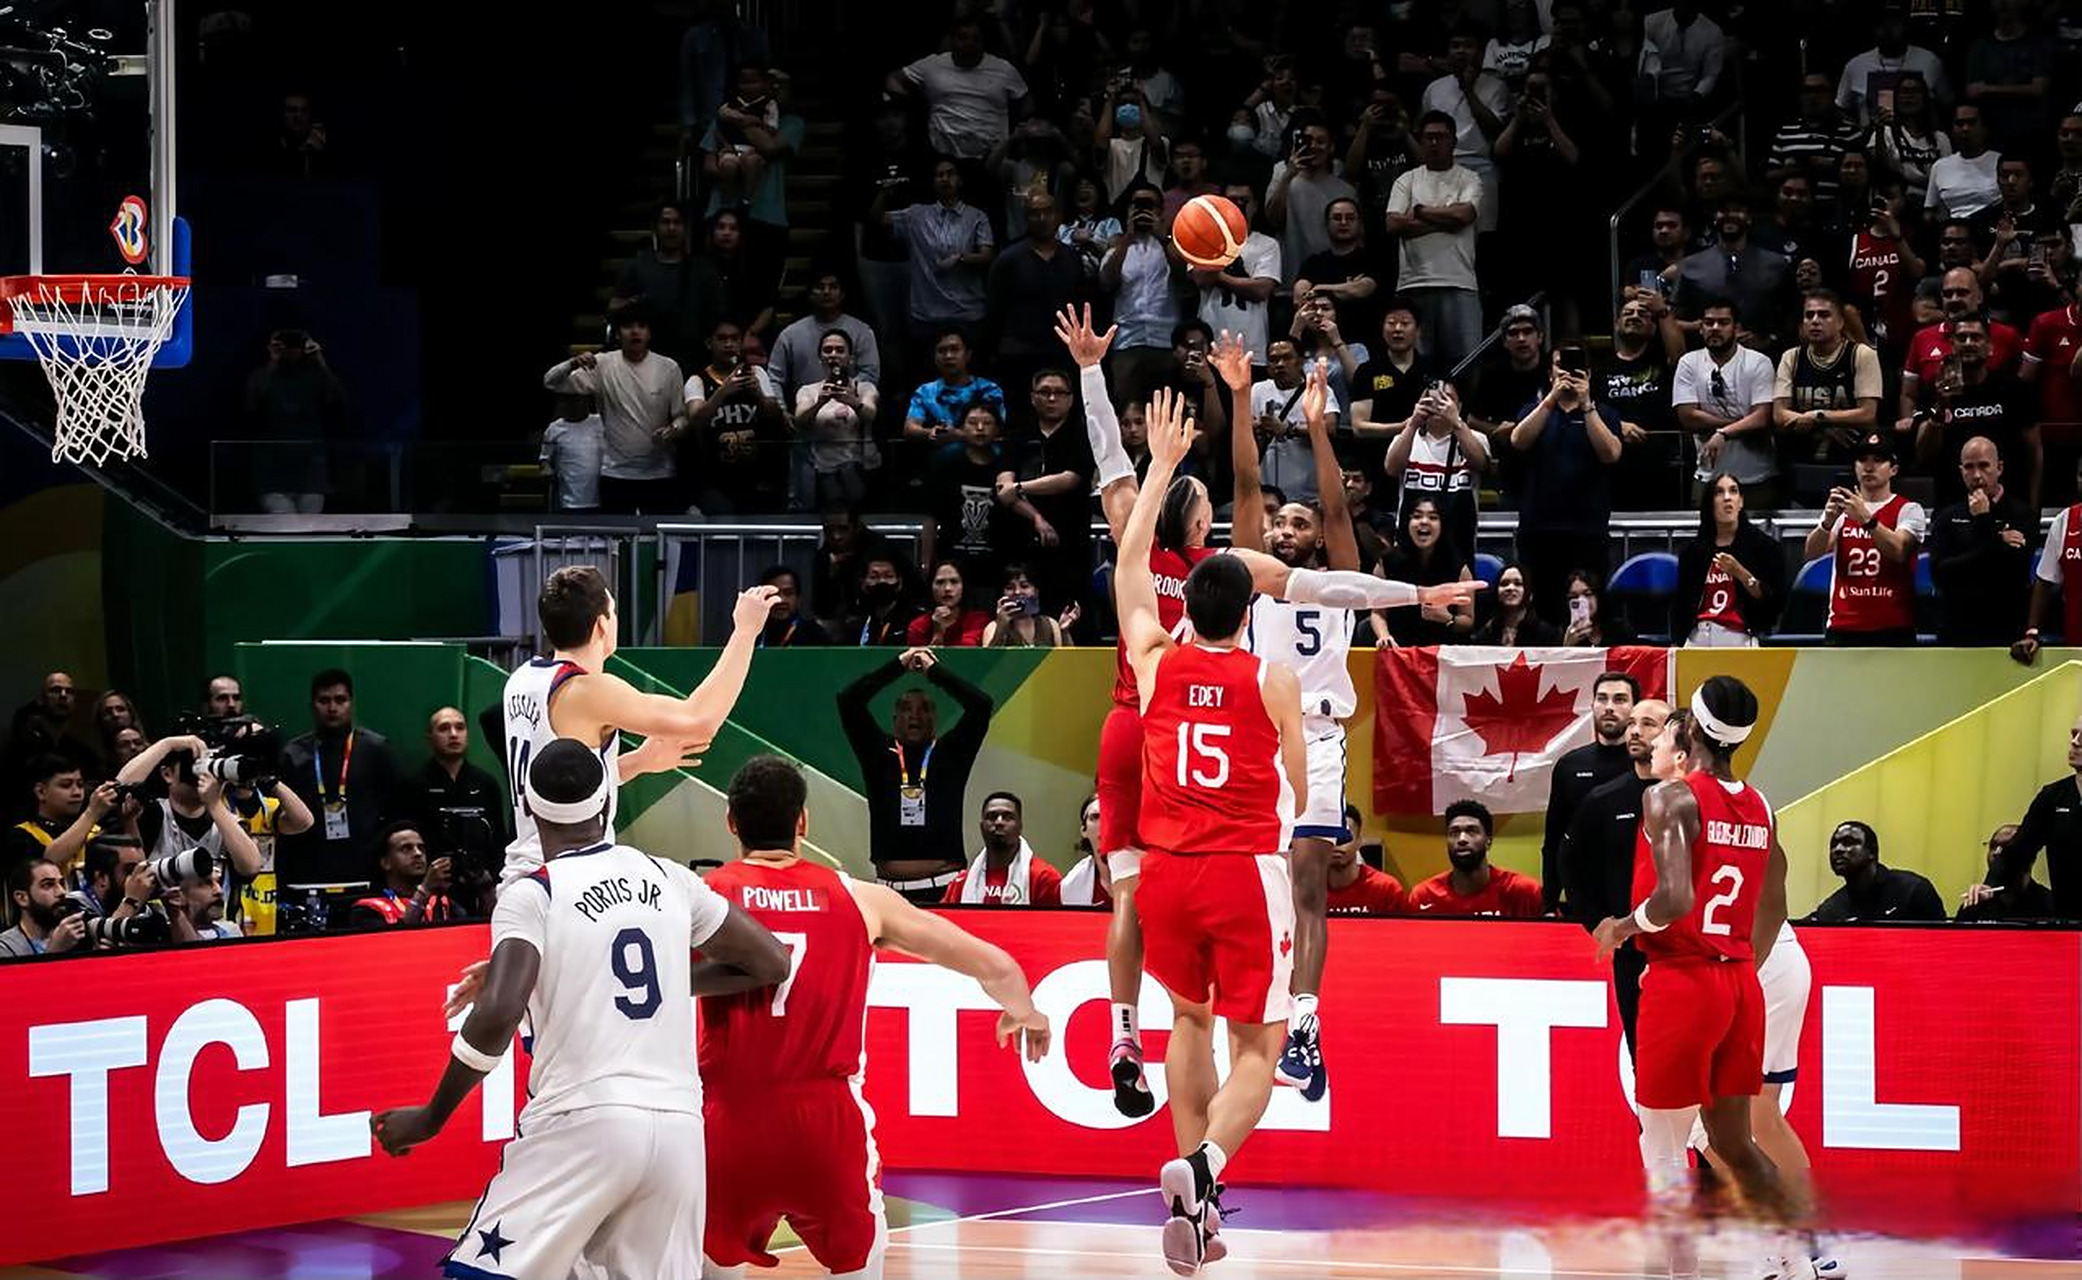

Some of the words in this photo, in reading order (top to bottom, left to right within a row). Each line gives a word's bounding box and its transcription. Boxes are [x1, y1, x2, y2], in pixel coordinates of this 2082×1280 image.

[1856, 253, 1899, 269] CANAD
[1873, 270, 1889, 296] 2
[1796, 385, 1848, 407] USA
[1954, 403, 2003, 418] CANADA
[1842, 527, 1872, 539] CAN
[1848, 547, 1881, 576] 23
[2066, 547, 2081, 559] CA
[1154, 573, 1187, 601] ROOK
[1704, 572, 1733, 584] ANA
[1709, 590, 1728, 615] 9
[1849, 586, 1870, 596] Sun
[1872, 586, 1894, 597] Life
[1296, 610, 1321, 656] 5
[1189, 684, 1224, 707] EDEY
[1177, 721, 1231, 788] 15
[574, 878, 632, 923] PORTIS
[638, 879, 662, 912] JR.
[742, 886, 820, 911] POWELL
[1702, 864, 1744, 936] 2
[611, 927, 663, 1020] 9
[771, 931, 807, 1016] 7
[1440, 977, 1960, 1151] TL
[29, 998, 372, 1195] TCL
